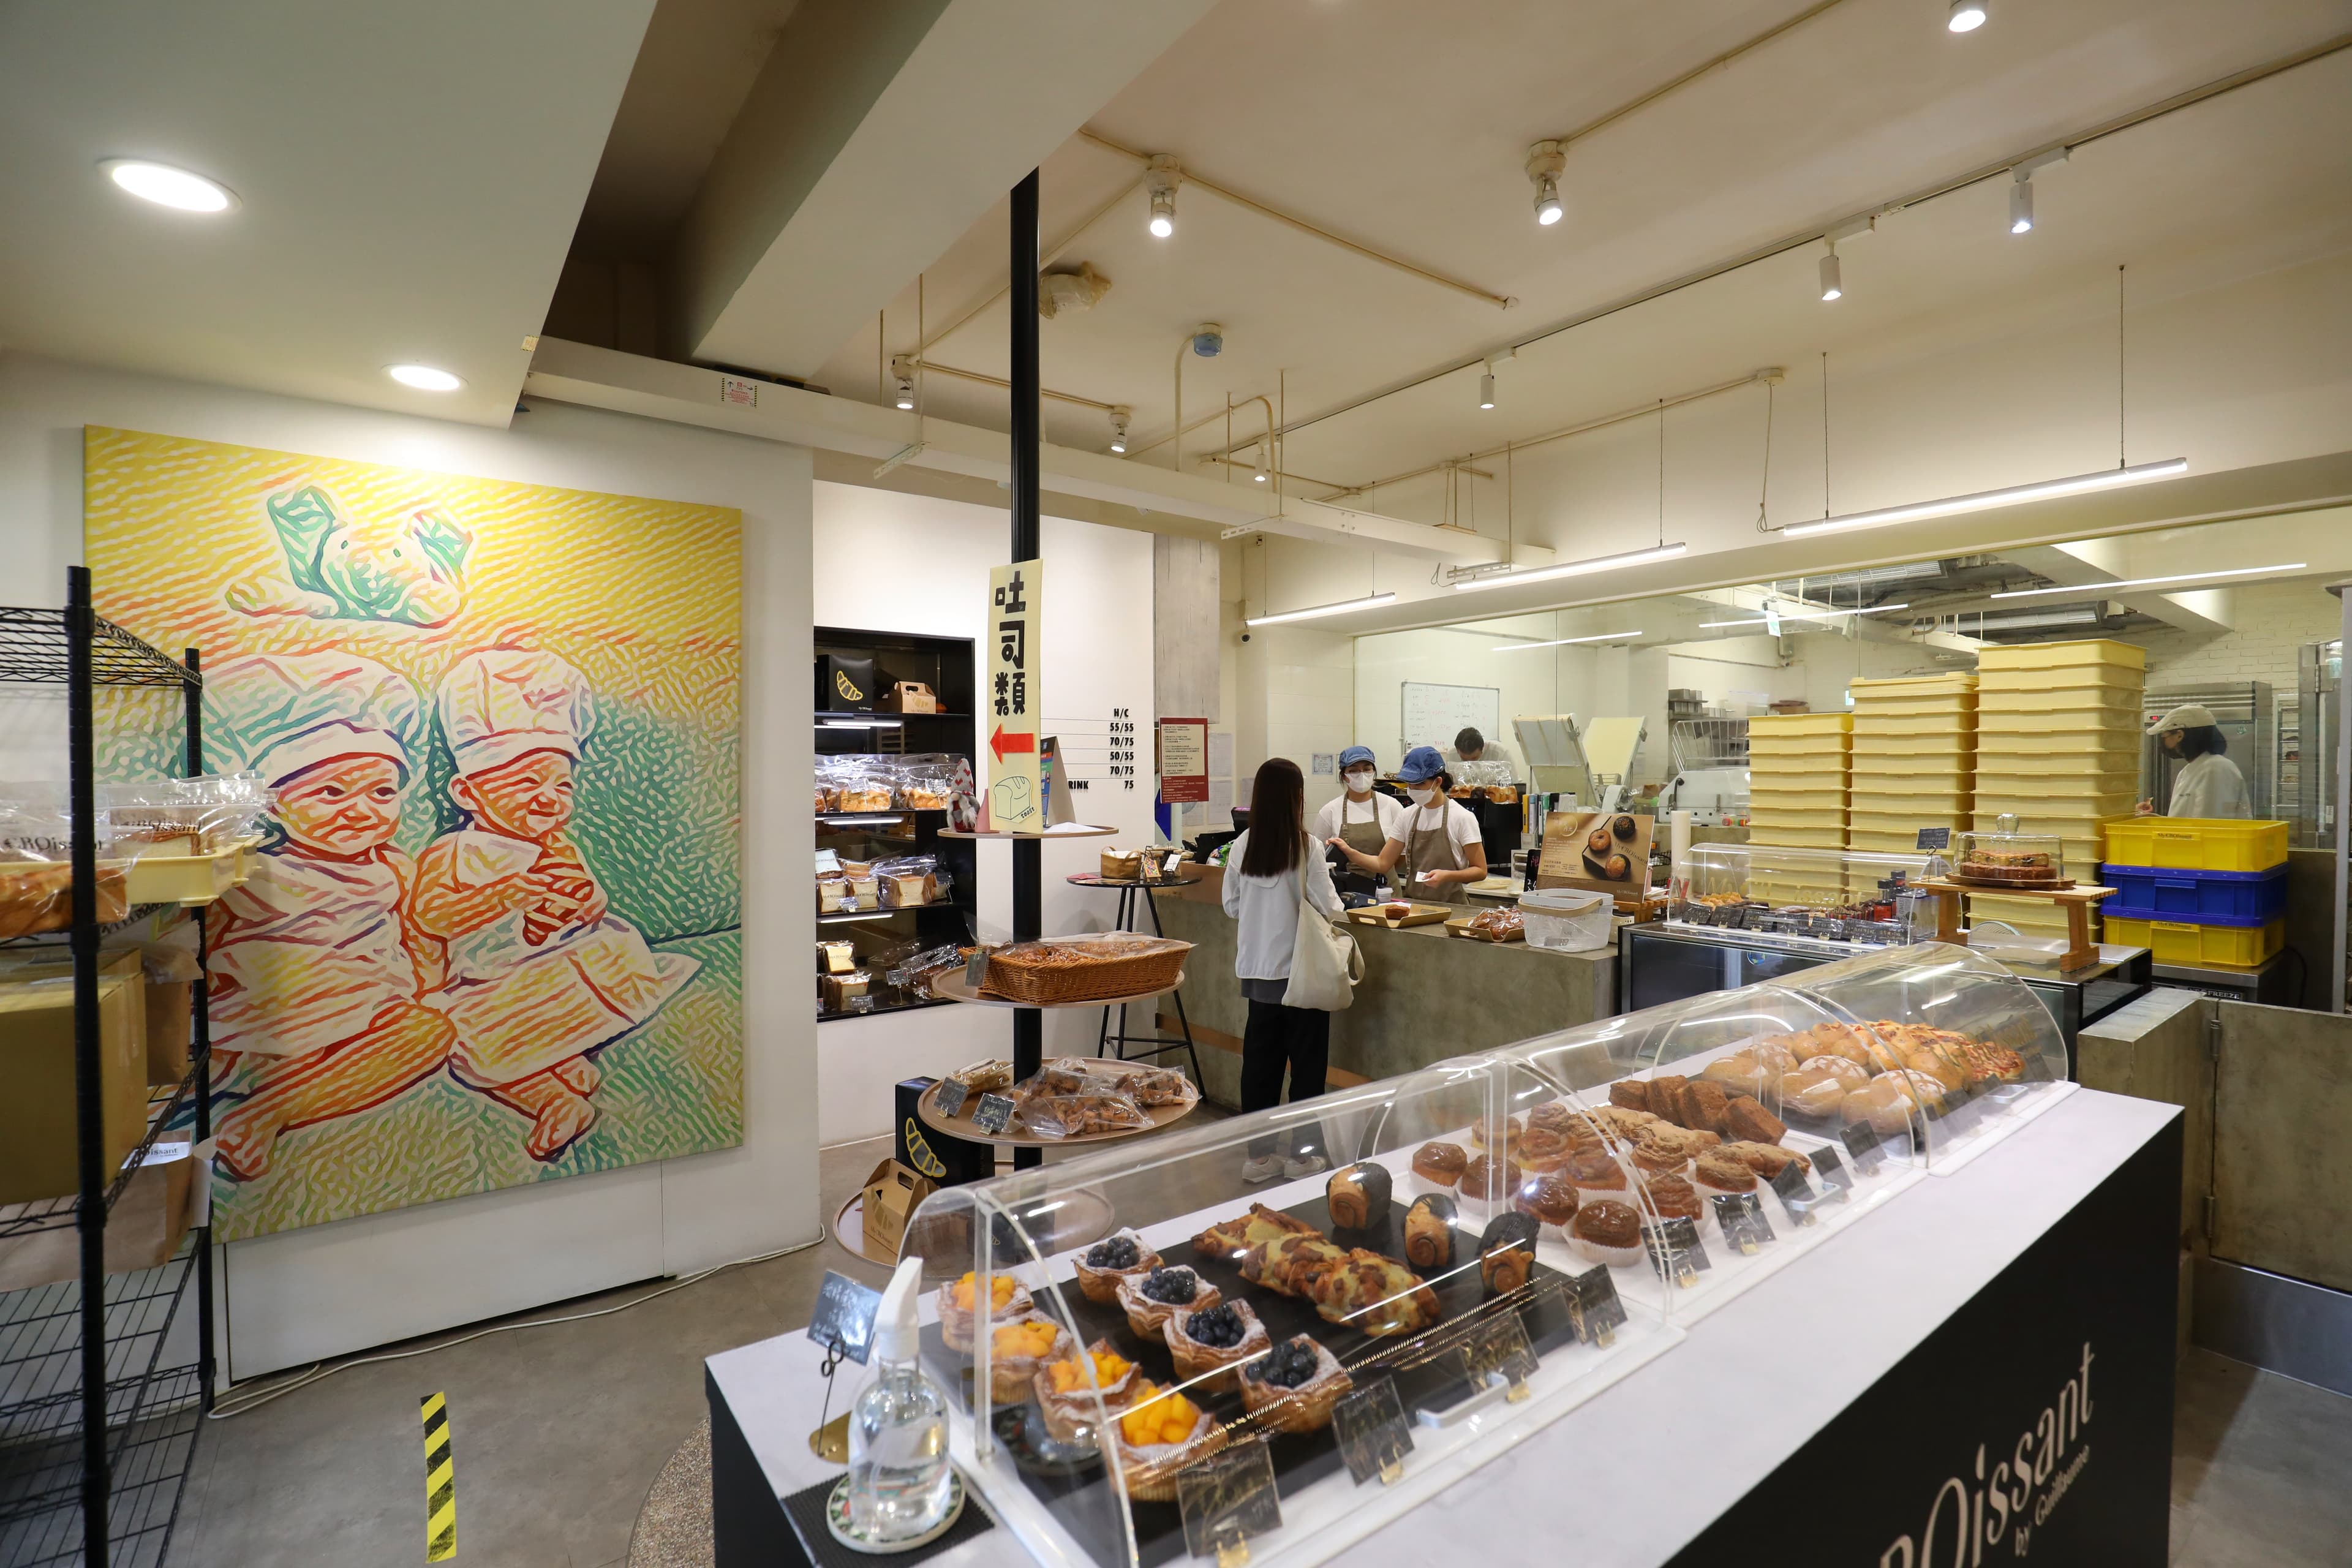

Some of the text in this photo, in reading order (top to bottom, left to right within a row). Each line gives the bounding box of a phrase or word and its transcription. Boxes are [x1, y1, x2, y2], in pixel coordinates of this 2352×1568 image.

[995, 570, 1026, 717] 吐司類
[1114, 708, 1129, 719] H/C
[1110, 723, 1134, 733] 55/55
[1110, 737, 1134, 748] 70/75
[1110, 752, 1134, 763] 50/55
[1110, 766, 1134, 777] 70/75
[1068, 780, 1134, 790] RINK 75
[1021, 807, 1035, 818] toast
[2207, 990, 2240, 1000] FREEZE
[1880, 1341, 2095, 1568] Oissant
